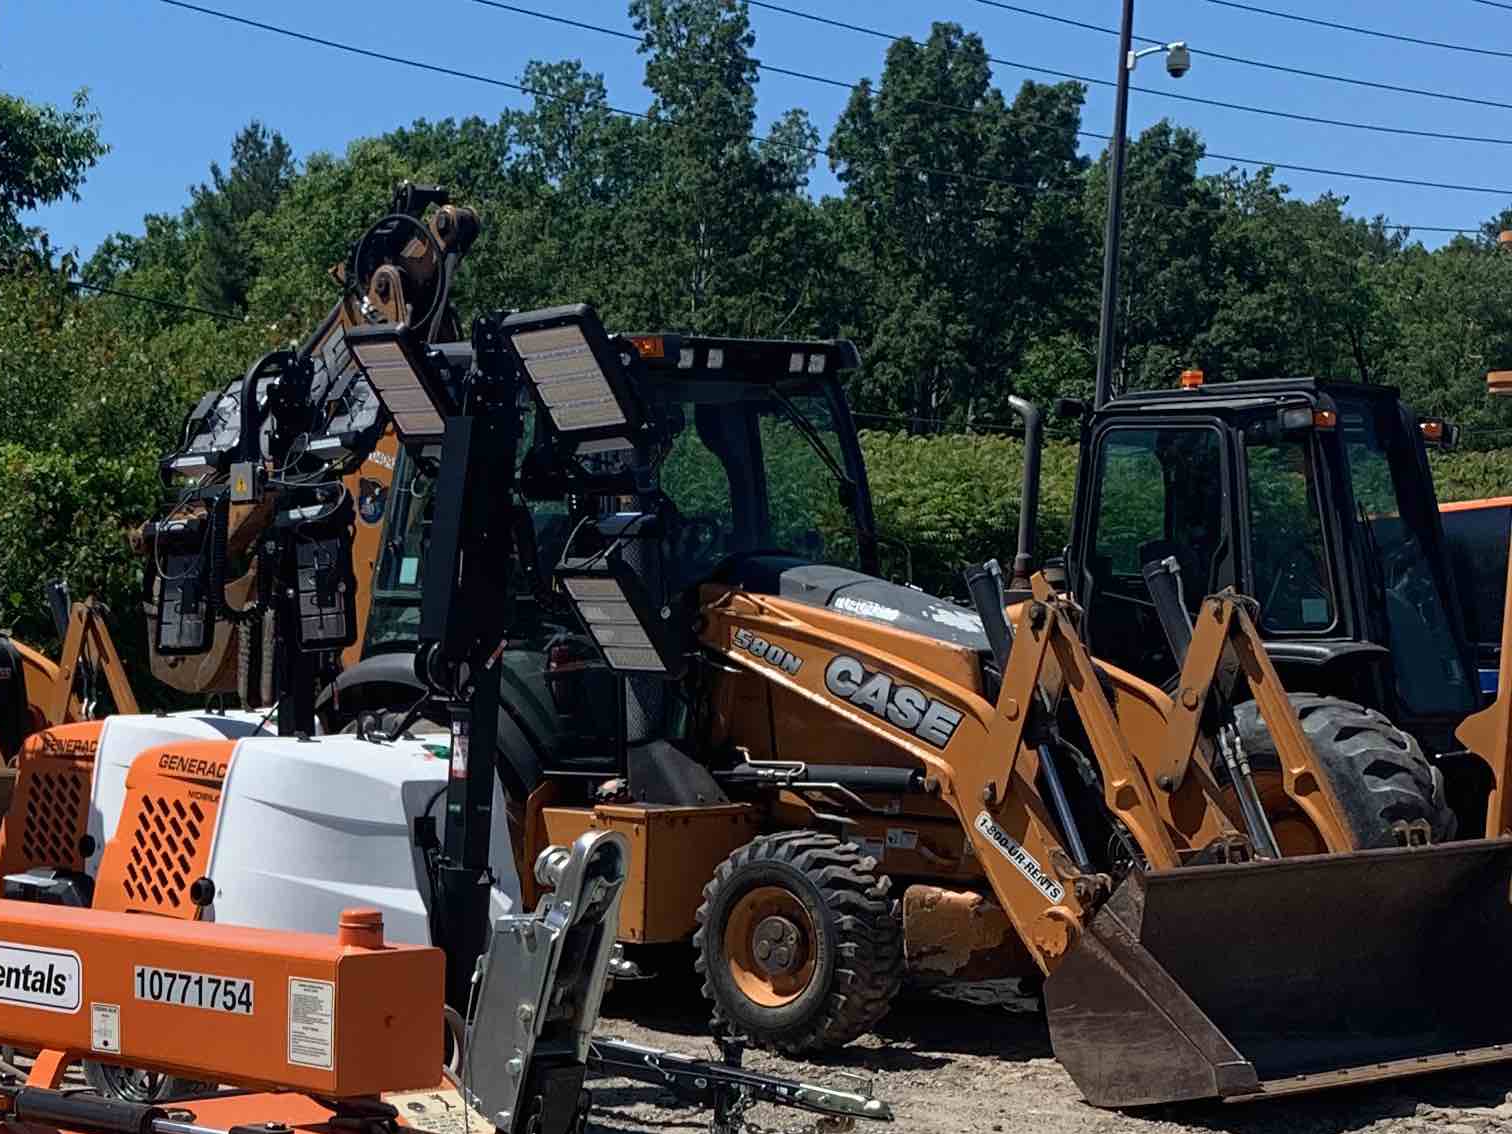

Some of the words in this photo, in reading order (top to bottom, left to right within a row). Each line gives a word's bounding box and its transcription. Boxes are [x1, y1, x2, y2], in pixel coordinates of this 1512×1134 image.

[734, 628, 804, 675] 580N
[824, 655, 966, 749] CASE
[158, 753, 228, 779] GENERAC
[980, 817, 1061, 898] 1-800-UR-RENTS
[136, 968, 253, 1013] 10771754
